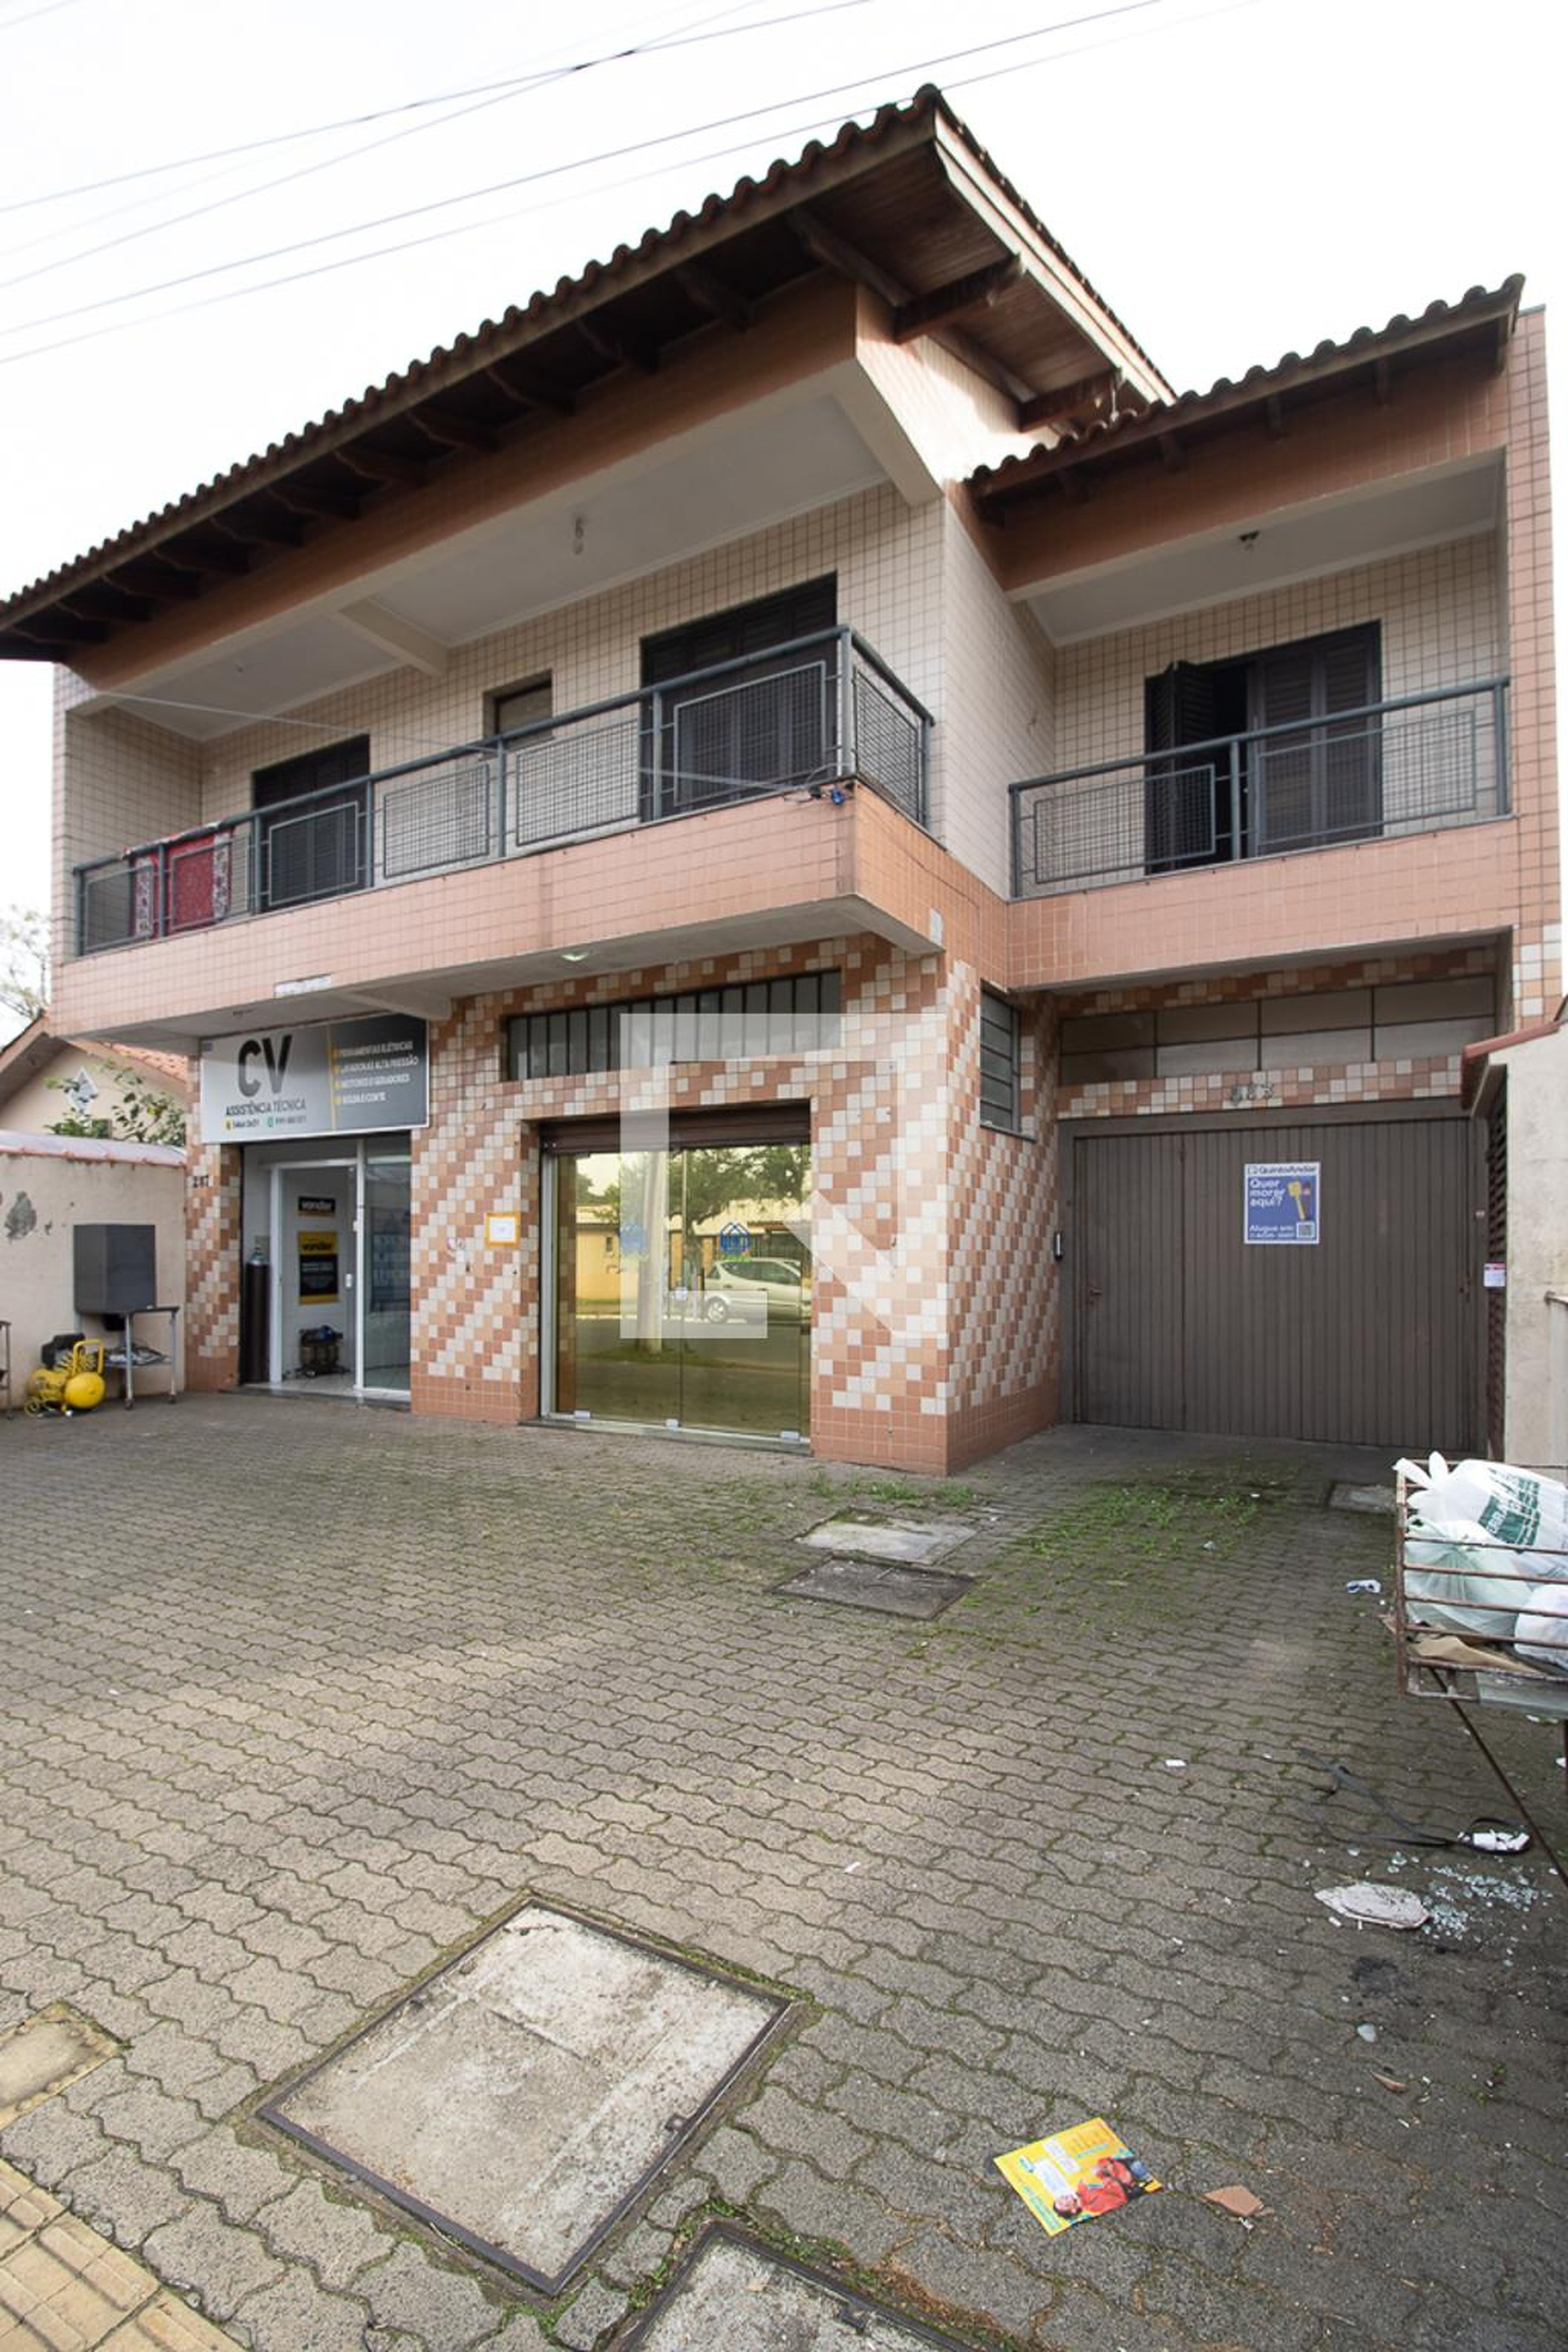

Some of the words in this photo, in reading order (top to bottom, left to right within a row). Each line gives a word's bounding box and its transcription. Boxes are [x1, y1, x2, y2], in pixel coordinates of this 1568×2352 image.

[238, 1035, 292, 1097] CV
[226, 1100, 271, 1115] ASSISTÊNCIA
[273, 1098, 305, 1112] TÉCNICA
[1259, 1165, 1316, 1174] QuintoAndar
[1250, 1178, 1280, 1189] Quer
[1250, 1188, 1285, 1197] morar
